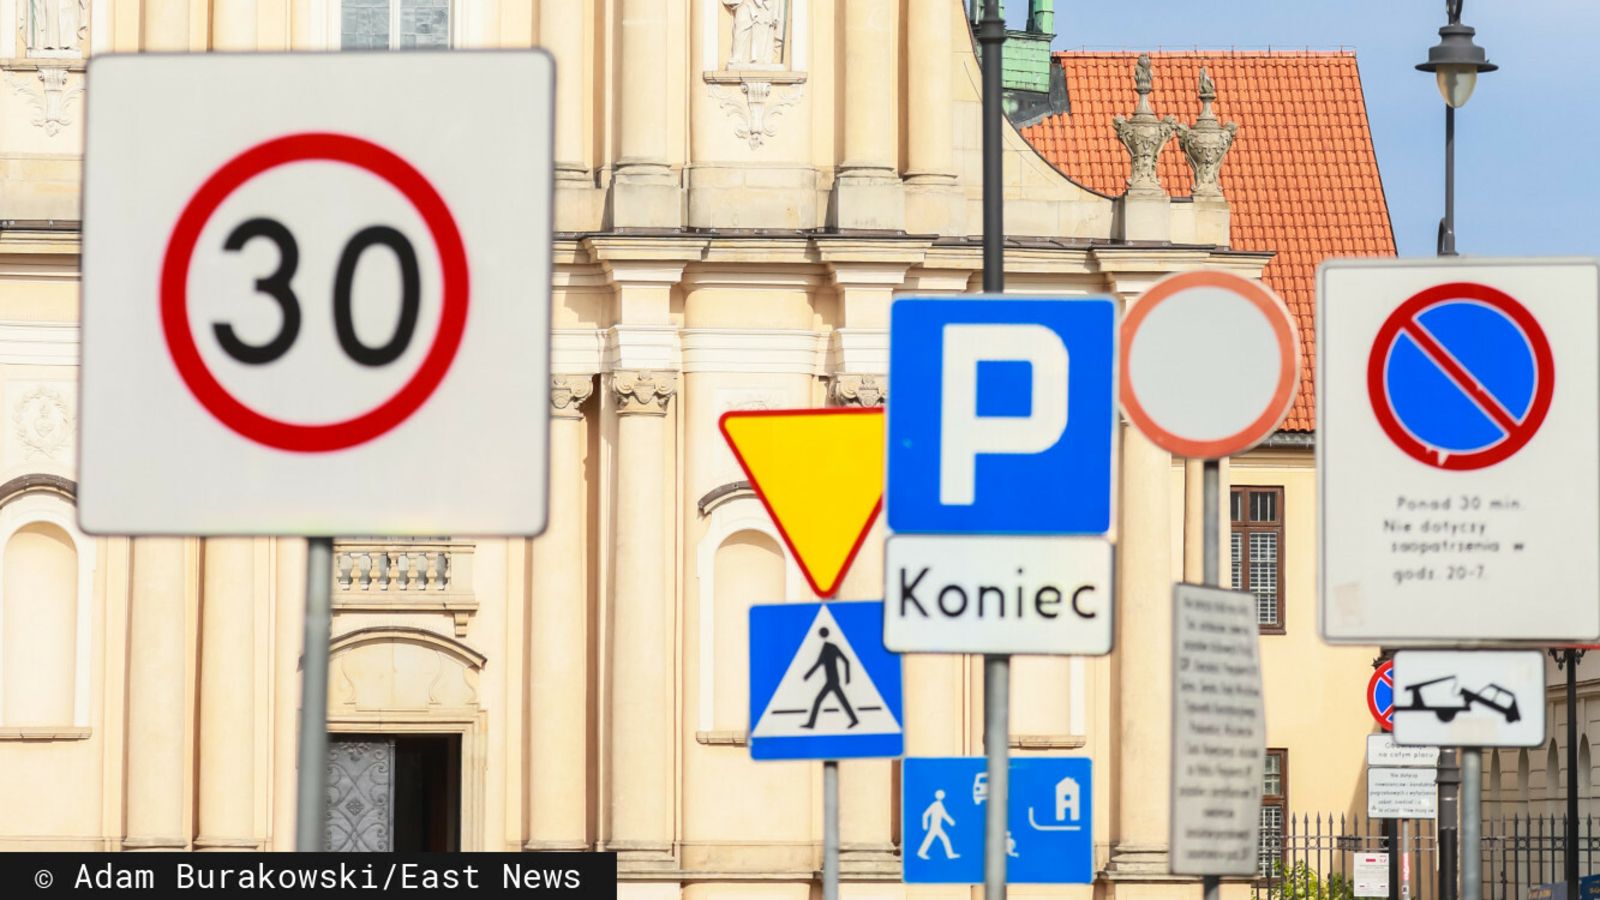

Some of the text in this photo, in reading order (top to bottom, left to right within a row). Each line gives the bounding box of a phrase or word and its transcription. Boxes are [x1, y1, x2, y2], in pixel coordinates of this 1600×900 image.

[212, 216, 422, 368] 30
[940, 324, 1070, 506] P
[1383, 519, 1487, 536] Nie dotyczy
[1396, 495, 1453, 511] Ponad
[1460, 495, 1482, 511] 30
[898, 567, 1098, 620] Koniec
